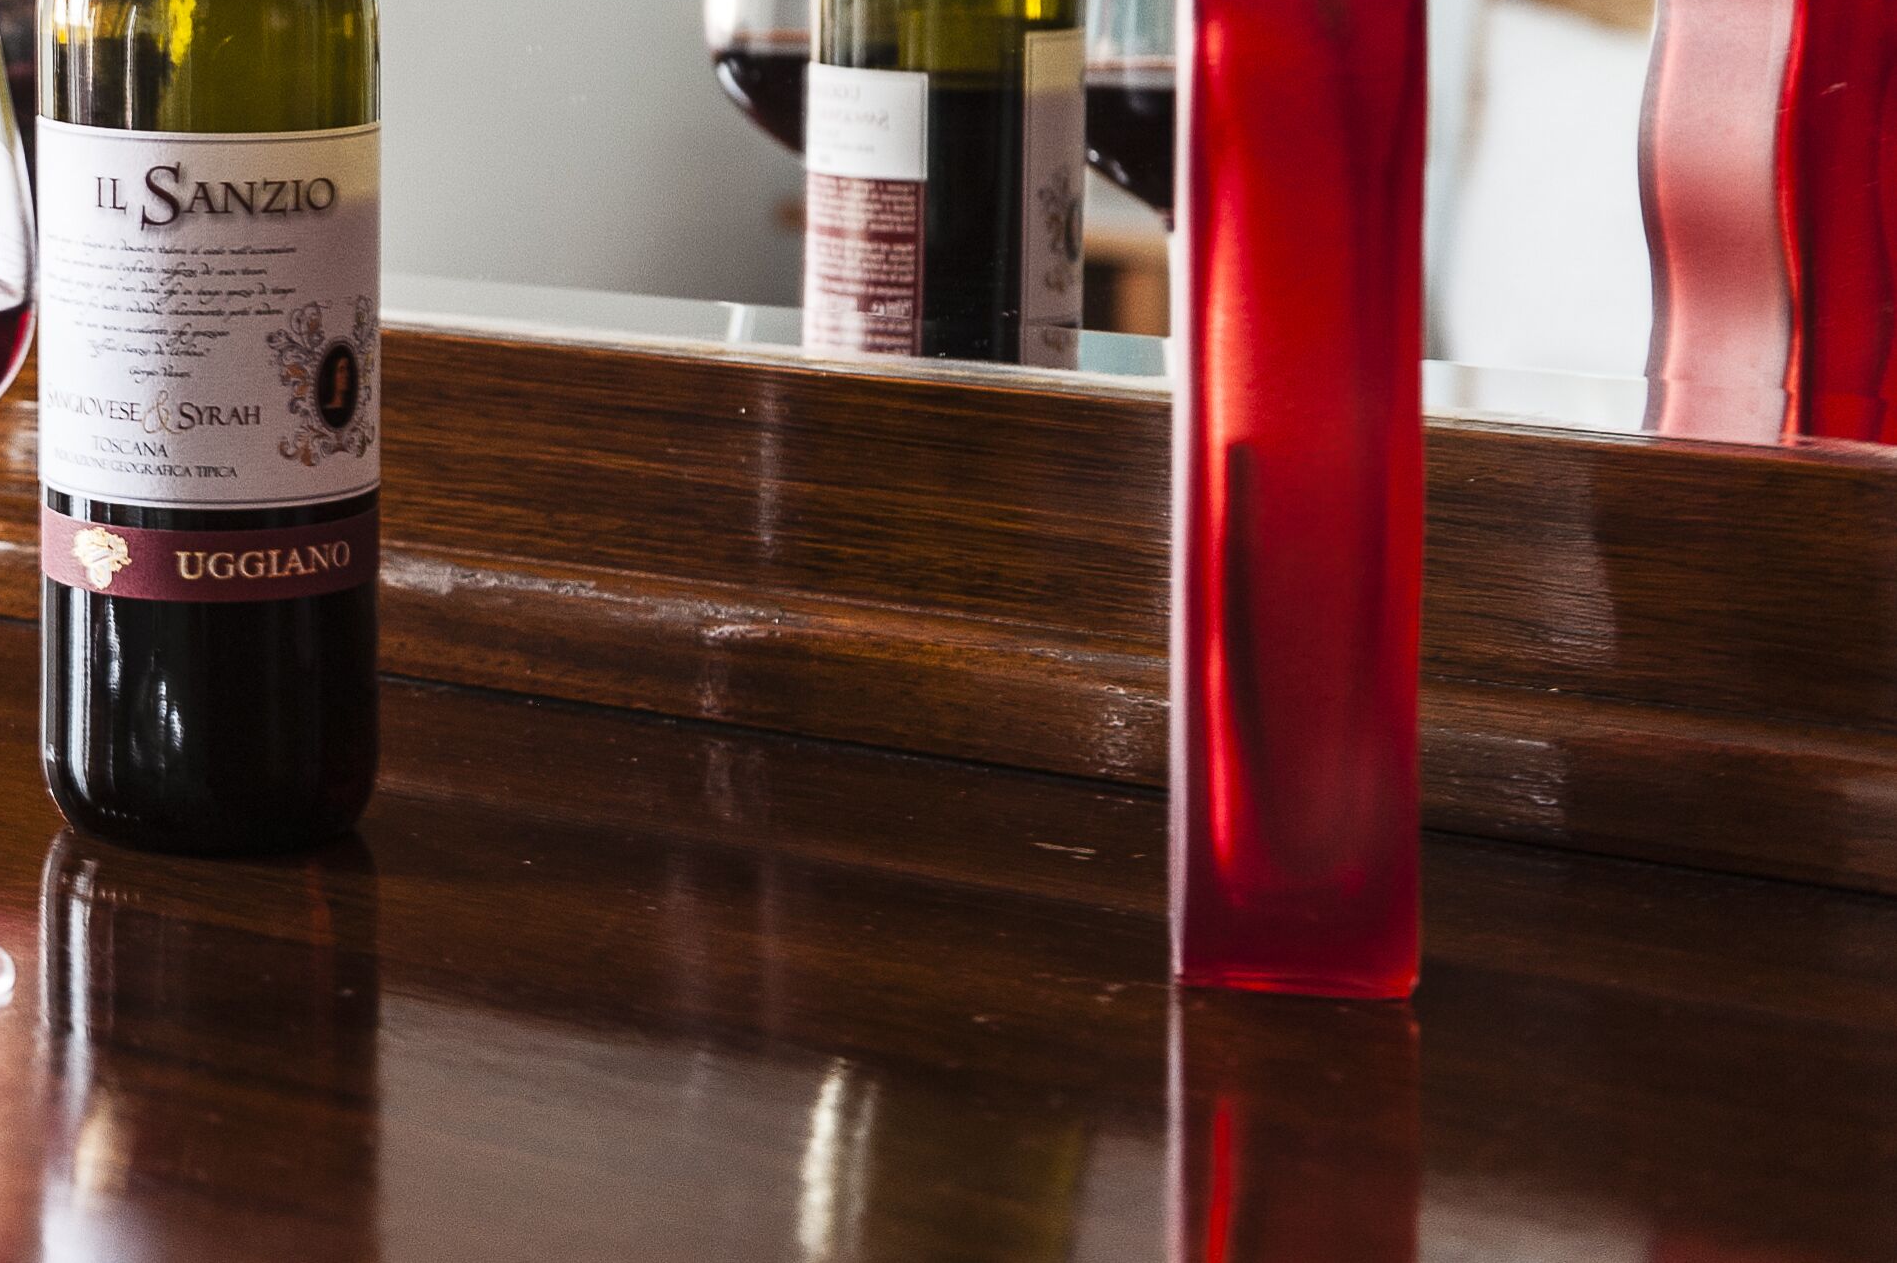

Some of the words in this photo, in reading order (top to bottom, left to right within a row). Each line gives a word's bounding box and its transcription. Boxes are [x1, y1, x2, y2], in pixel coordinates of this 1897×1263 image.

[95, 176, 128, 215] IL
[141, 389, 180, 435] &
[177, 401, 262, 430] SYRAH
[91, 435, 170, 459] TOSCANA
[110, 459, 193, 478] GEOGRAFICA
[194, 464, 239, 479] TIPICA
[173, 540, 351, 580] UGGIANO
